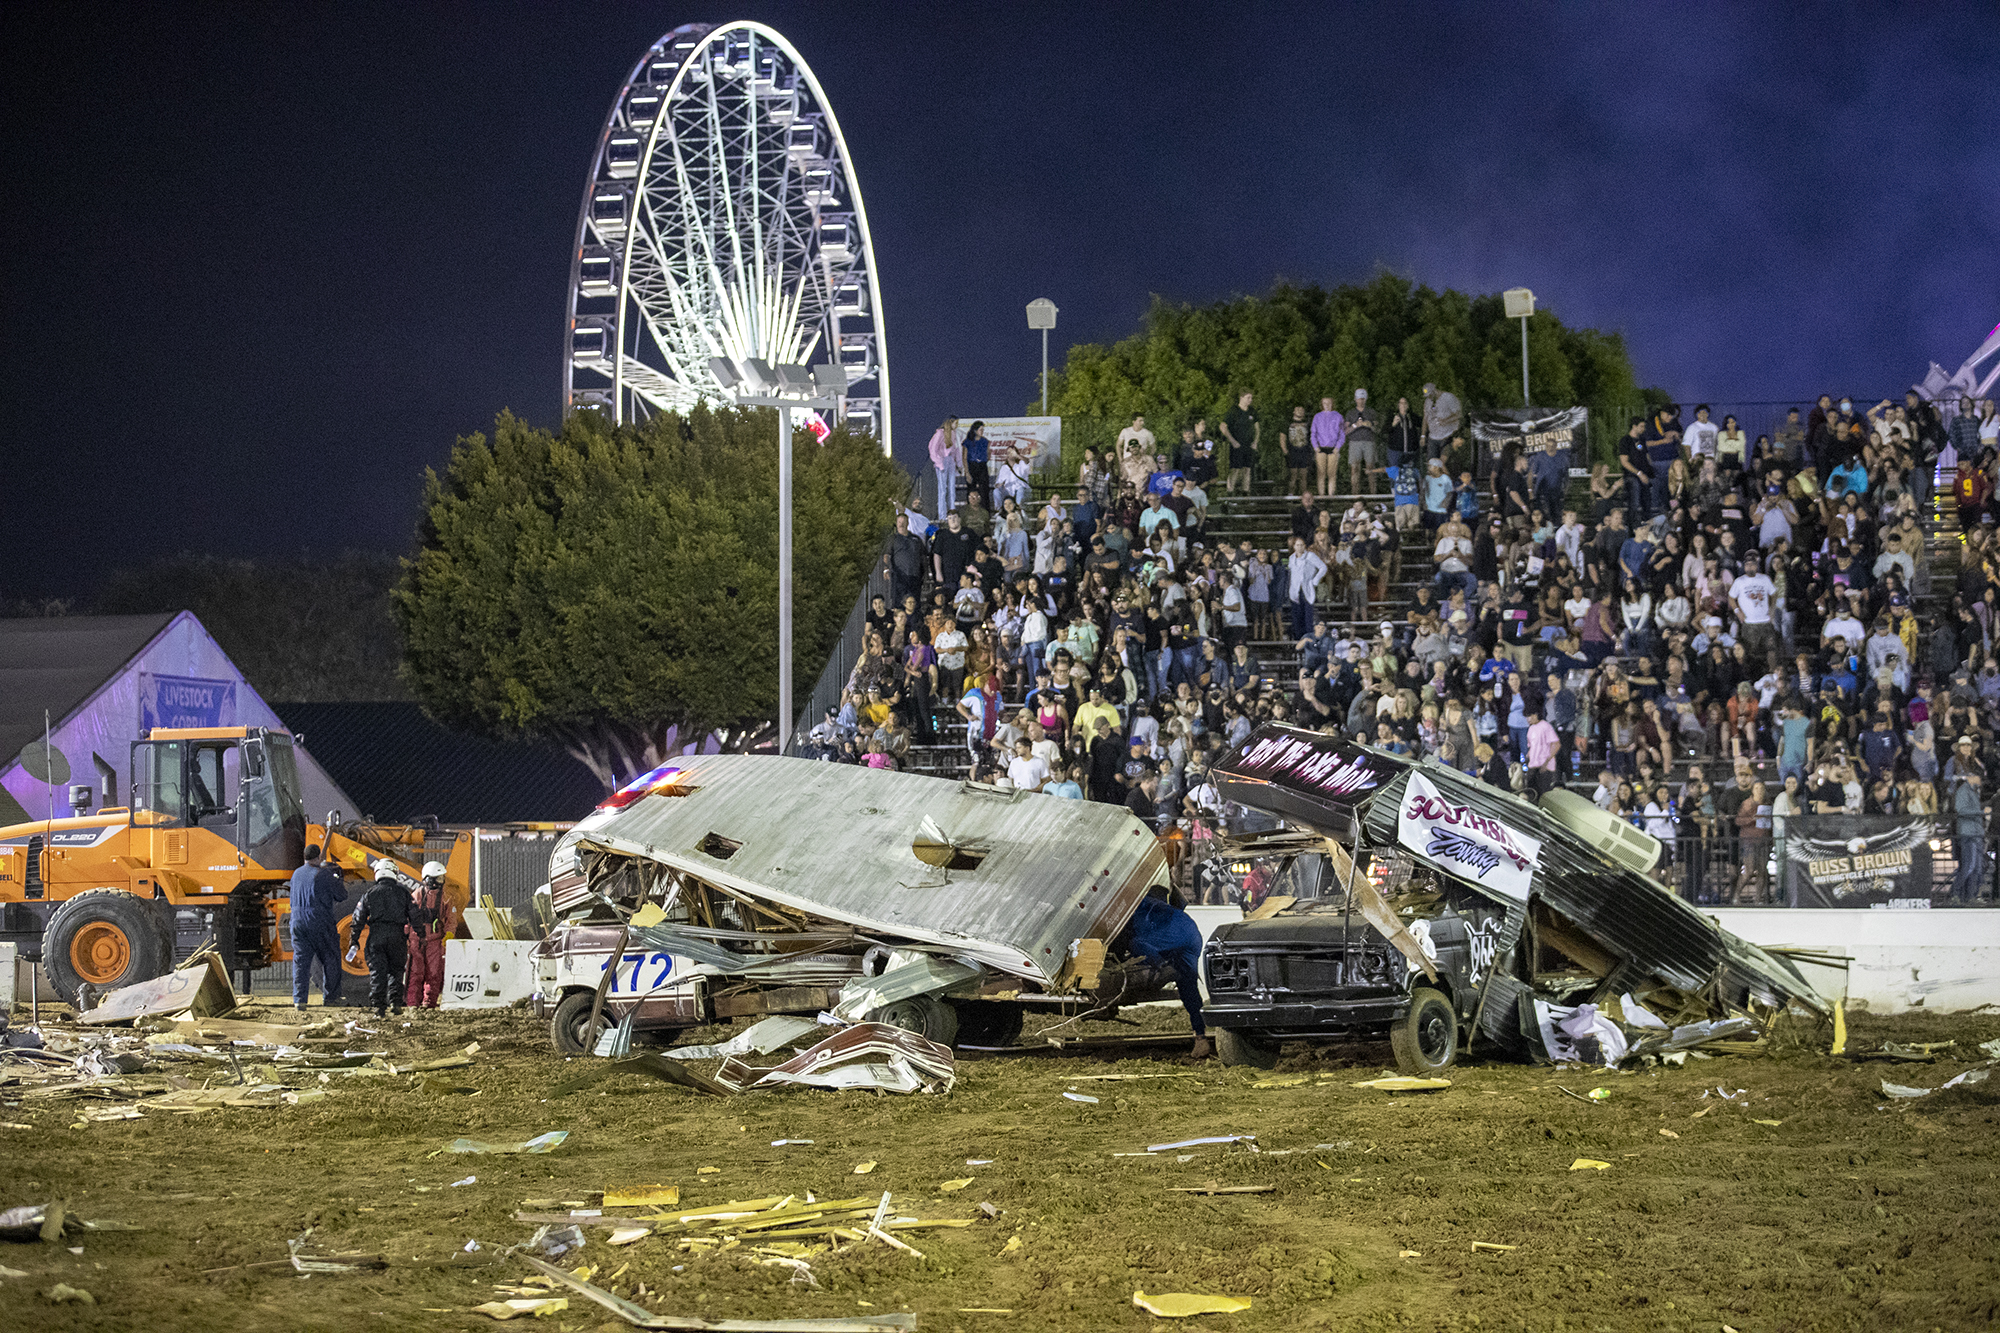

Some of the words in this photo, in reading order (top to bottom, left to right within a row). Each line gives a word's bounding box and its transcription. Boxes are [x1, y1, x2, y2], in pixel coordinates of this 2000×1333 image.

[1963, 478, 1973, 497] 9
[165, 685, 214, 709] LIVESTOCK
[52, 833, 97, 842] DL220
[1425, 825, 1501, 879] Towing
[1809, 858, 1850, 876] RUSS
[1853, 849, 1912, 870] BROWN
[1813, 870, 1864, 885] MOTORCYCLE
[1864, 865, 1909, 877] ATTORNEYS
[601, 952, 675, 993] 172
[455, 981, 475, 992] NTS
